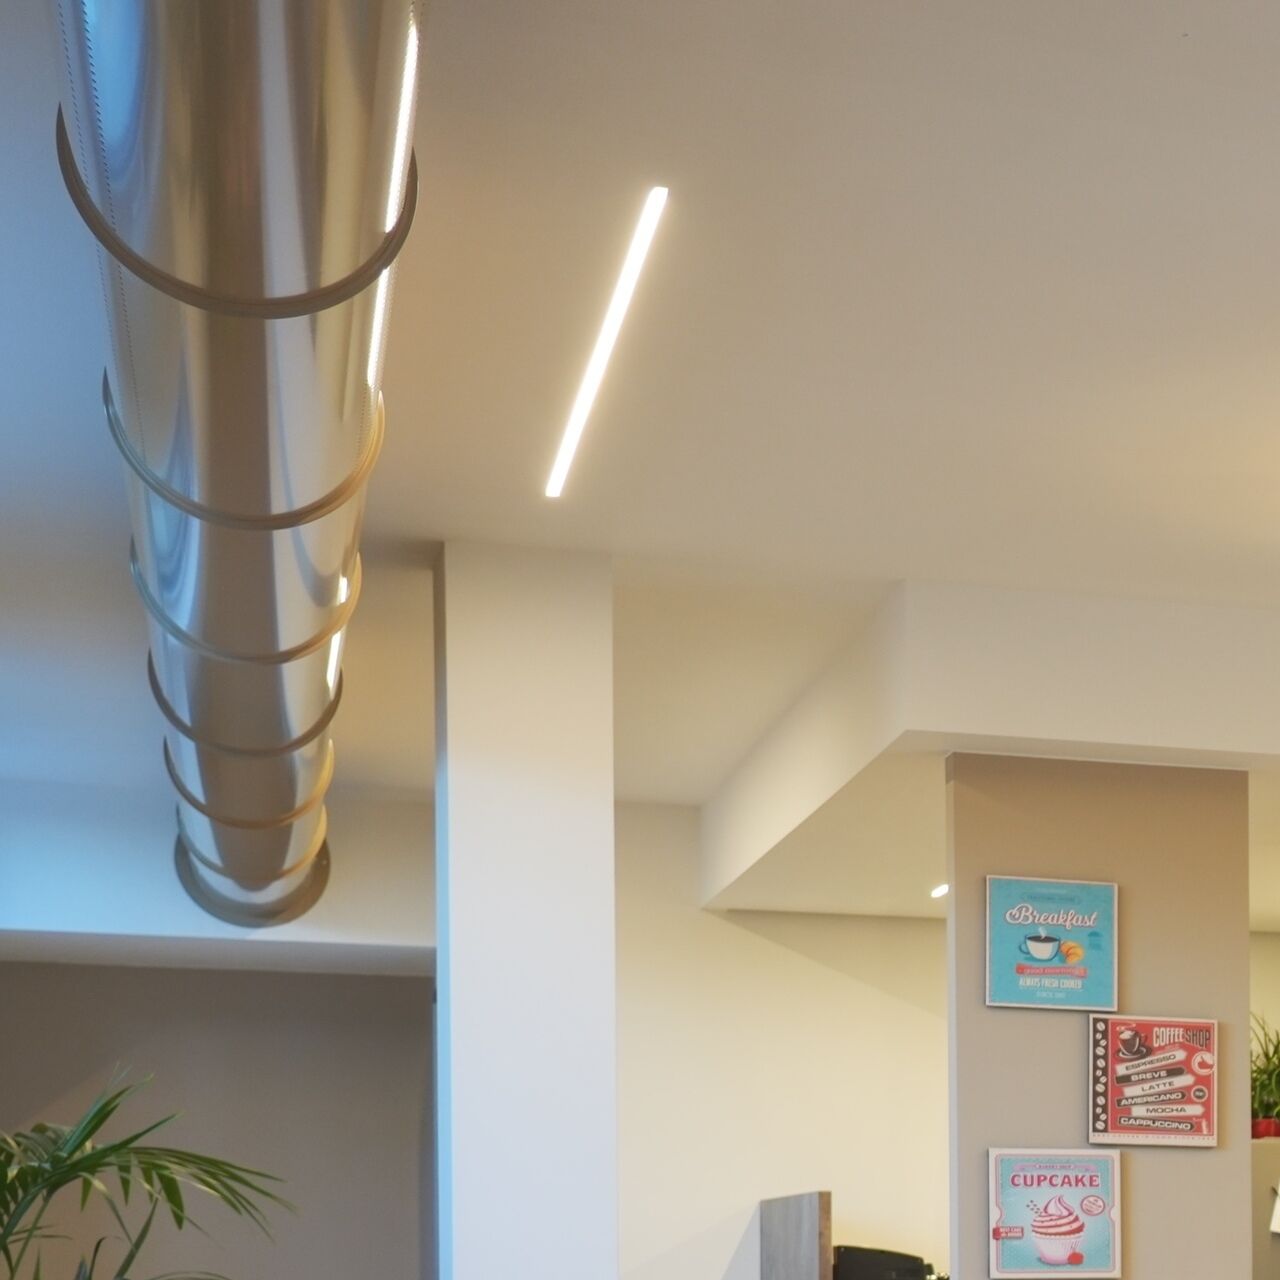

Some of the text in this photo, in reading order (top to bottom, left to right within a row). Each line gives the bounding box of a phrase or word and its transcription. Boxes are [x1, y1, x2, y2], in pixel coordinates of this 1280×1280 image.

[1005, 903, 1098, 930] Breakfast
[1153, 1027, 1210, 1049] COFFEE SHOP
[1125, 1053, 1177, 1071] ESPRESSO
[1131, 1070, 1168, 1082] BREVE
[1141, 1081, 1175, 1092] LATTE
[1120, 1092, 1182, 1106] AMERICANO
[1120, 1117, 1191, 1130] CAPPUCCINO
[1010, 1174, 1100, 1188] CUPCAKE
